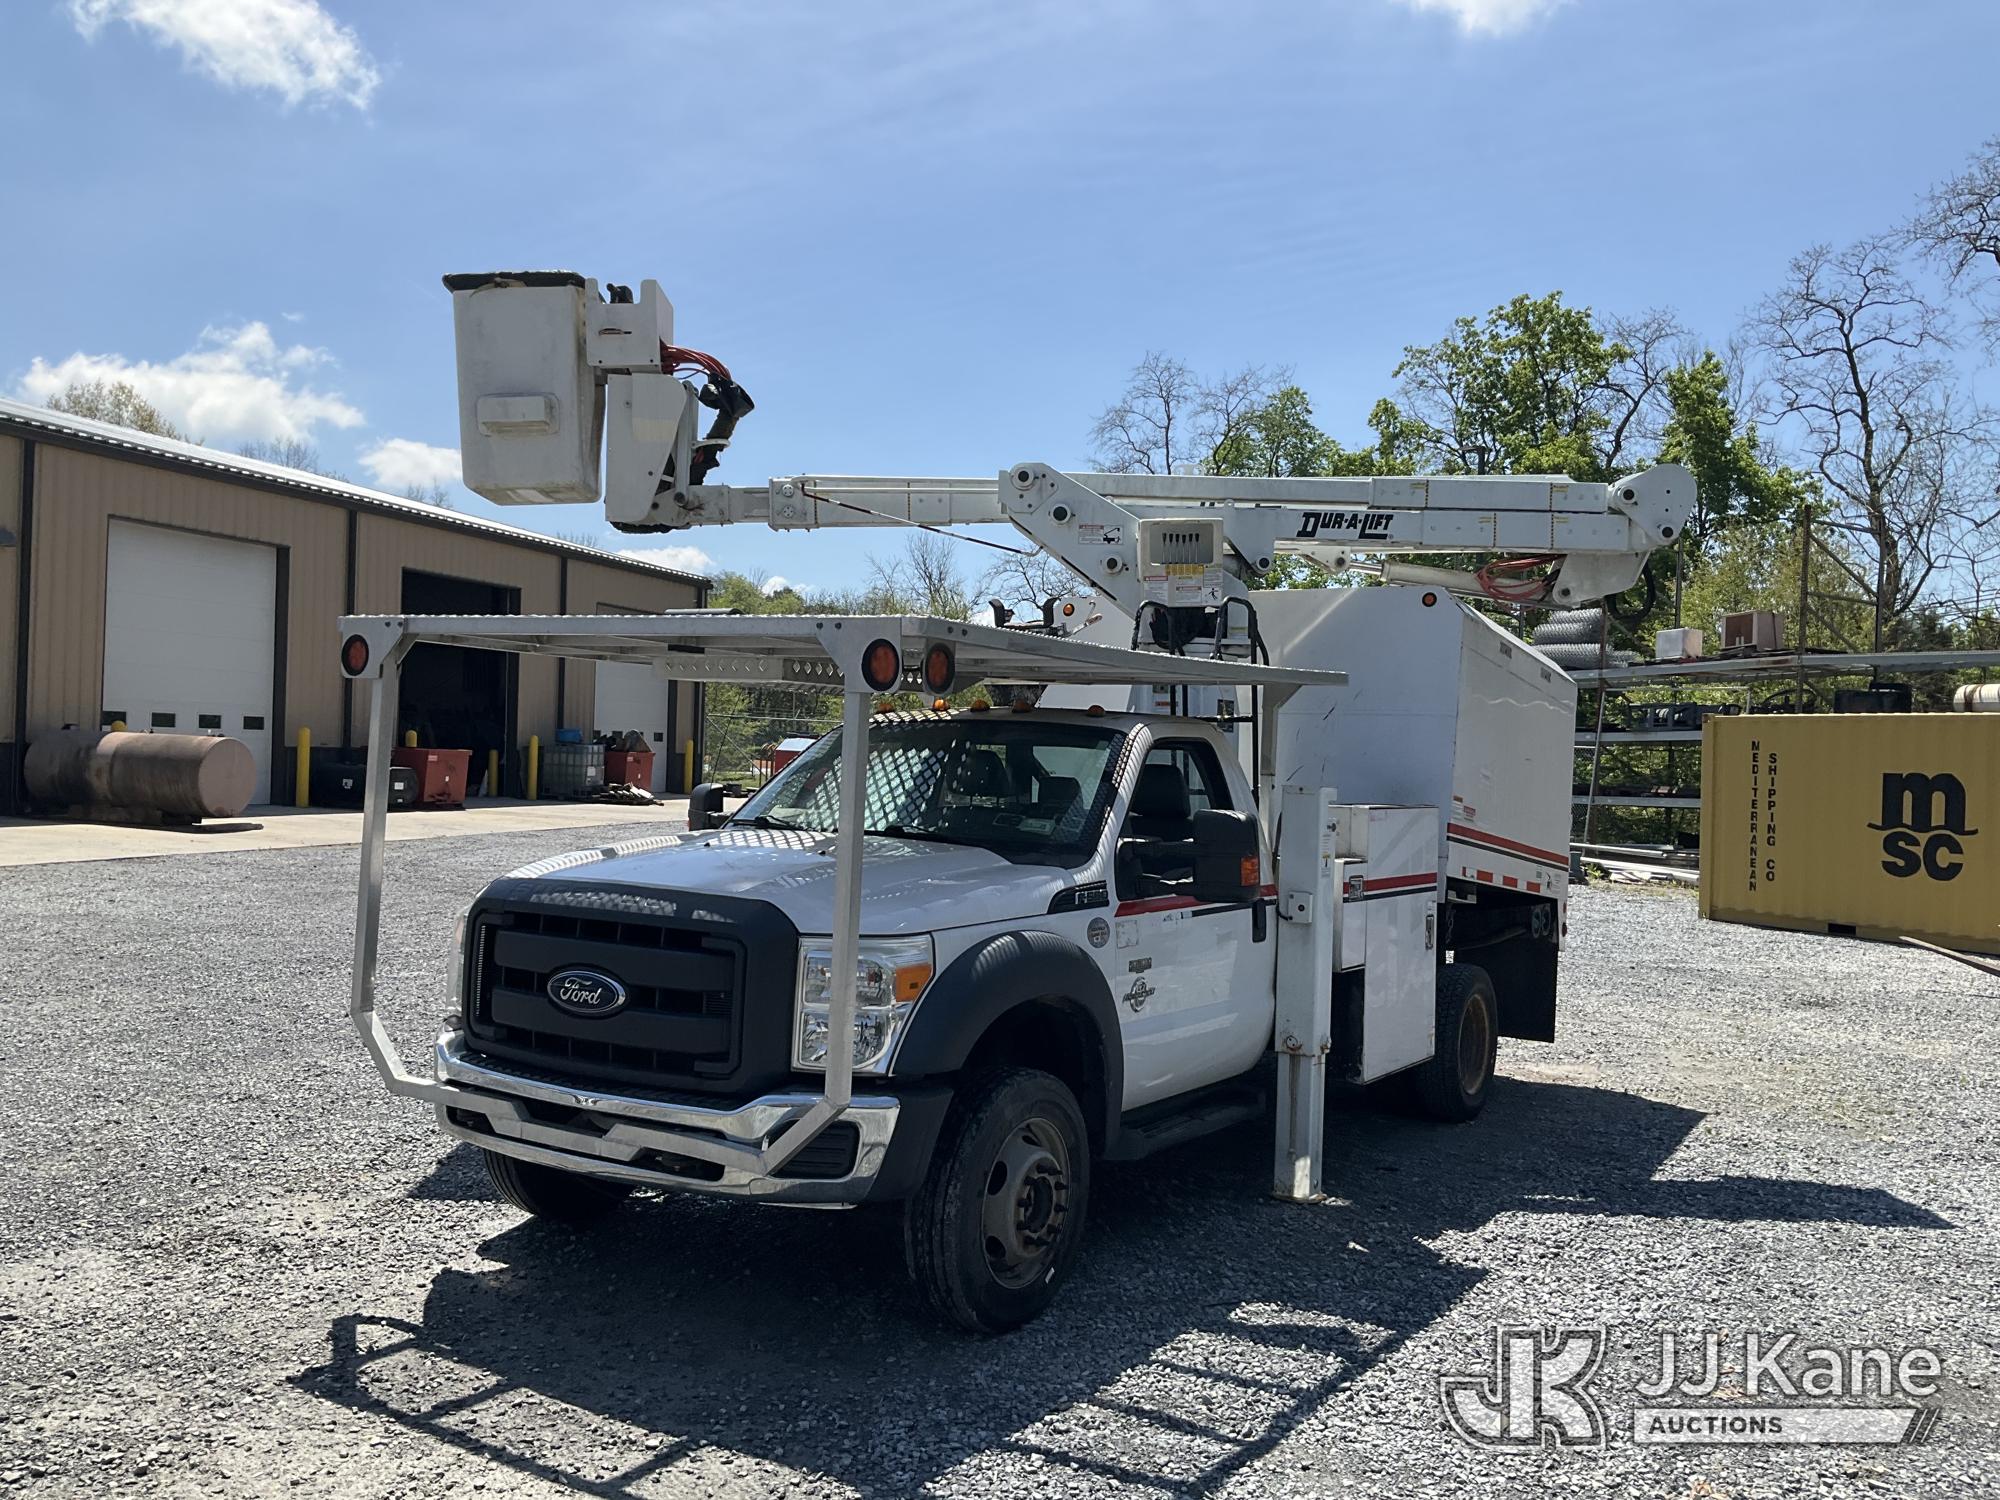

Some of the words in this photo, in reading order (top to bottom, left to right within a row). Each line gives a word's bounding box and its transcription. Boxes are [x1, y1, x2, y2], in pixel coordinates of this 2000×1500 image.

[1749, 741, 1760, 891] MEDITERRANEAN
[1767, 753, 1777, 846] SHIPPING
[1766, 859, 1775, 881] CO
[560, 976, 603, 1005] Ford
